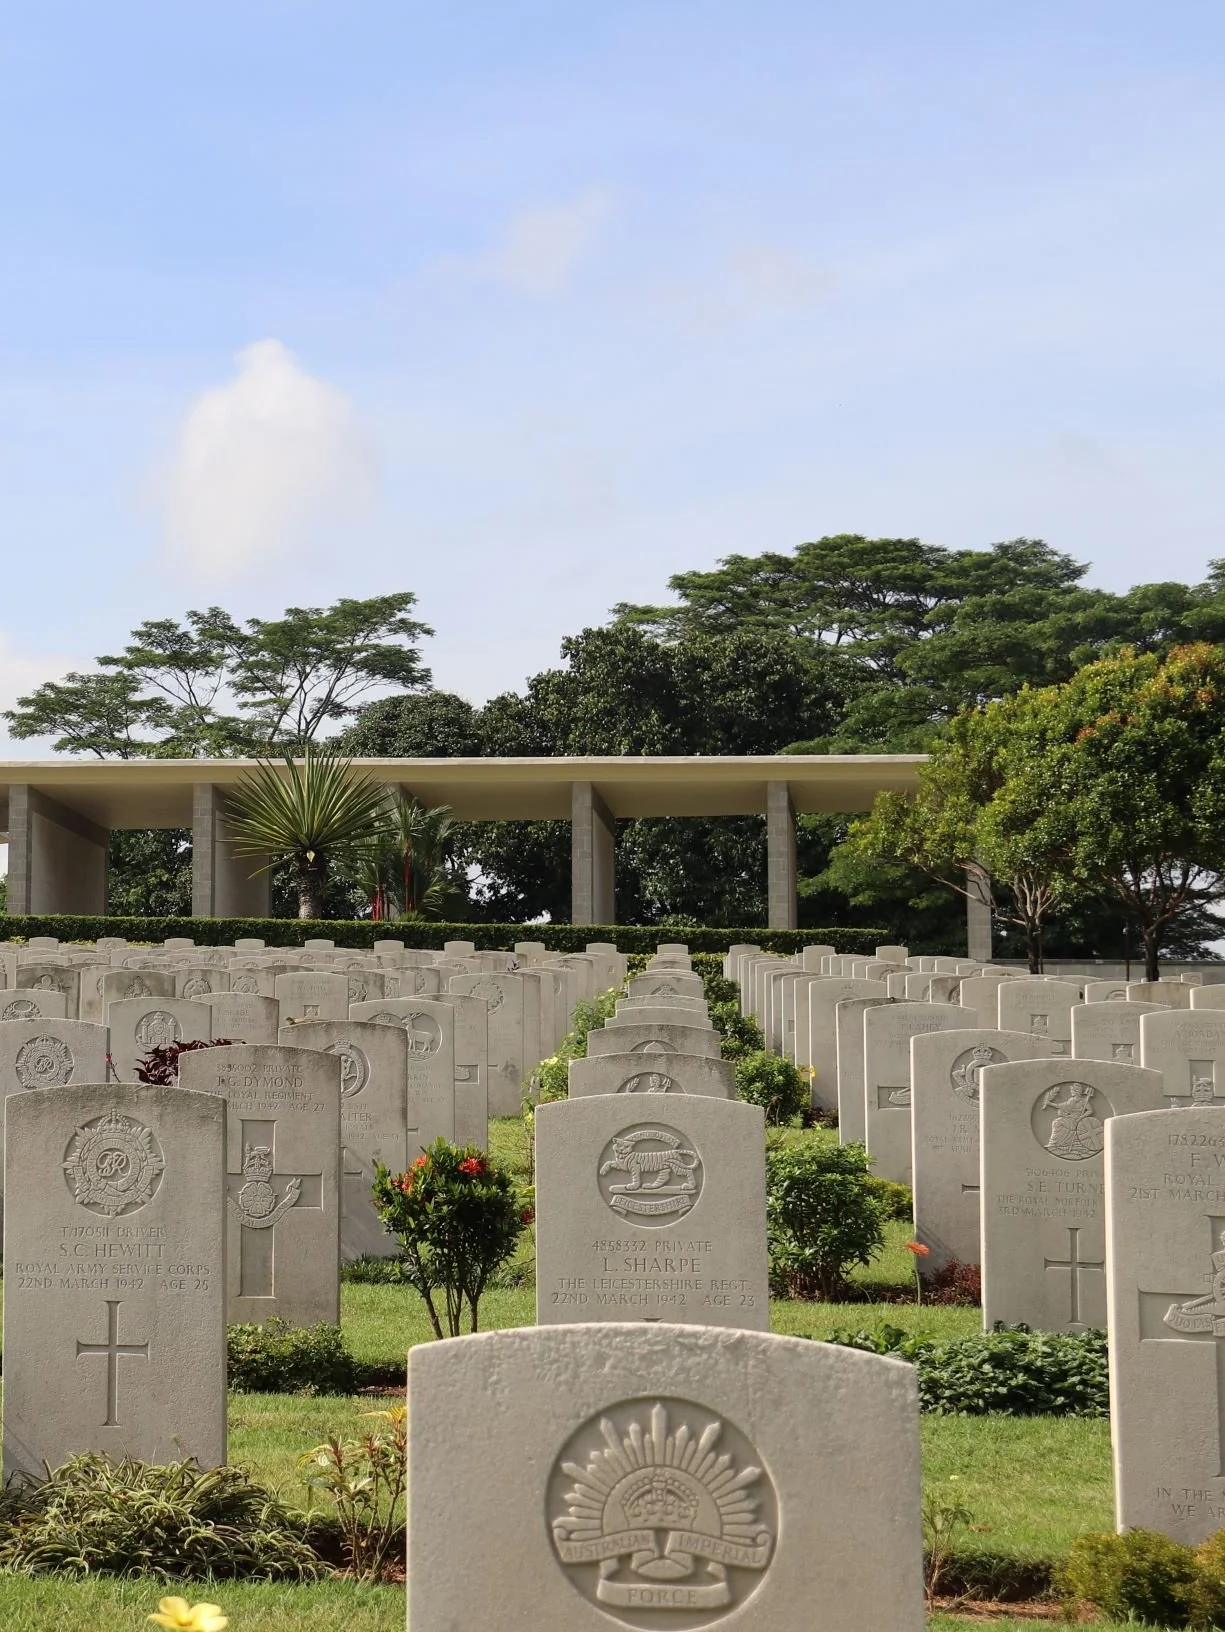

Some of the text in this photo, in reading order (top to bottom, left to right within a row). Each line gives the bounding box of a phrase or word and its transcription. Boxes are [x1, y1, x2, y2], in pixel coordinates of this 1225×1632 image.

[264, 1065, 303, 1073] PRIVATE
[244, 1077, 303, 1088] DYMOND
[228, 1091, 257, 1099] LOYAL
[264, 1092, 313, 1100] REGIMENT
[1163, 1173, 1215, 1186] ROYAL
[997, 1194, 1014, 1203] THE
[1019, 1196, 1048, 1205] ROYAL
[1129, 1187, 1225, 1201] 21ST MARCH
[117, 1227, 165, 1238] DRIVER
[59, 1243, 165, 1257] S.C. HEWITT
[592, 1240, 713, 1252] 4858332 PRIVATE
[15, 1263, 210, 1276] ROYAL ARMY SERVICE CORPS
[604, 1257, 701, 1273] L. SHARPE
[18, 1277, 209, 1290] 22ND MARCH 1942 AGE 25
[558, 1278, 585, 1289] THE
[593, 1279, 703, 1291] LEICESTERSHIRE
[551, 1292, 755, 1307] 22ND MARCH 1942 AGE 23
[1155, 1487, 1214, 1501] IN THE
[1171, 1504, 1196, 1517] WE
[563, 1534, 761, 1563] AUSTRALIAN IMPERIAL
[627, 1589, 698, 1605] FORCE
